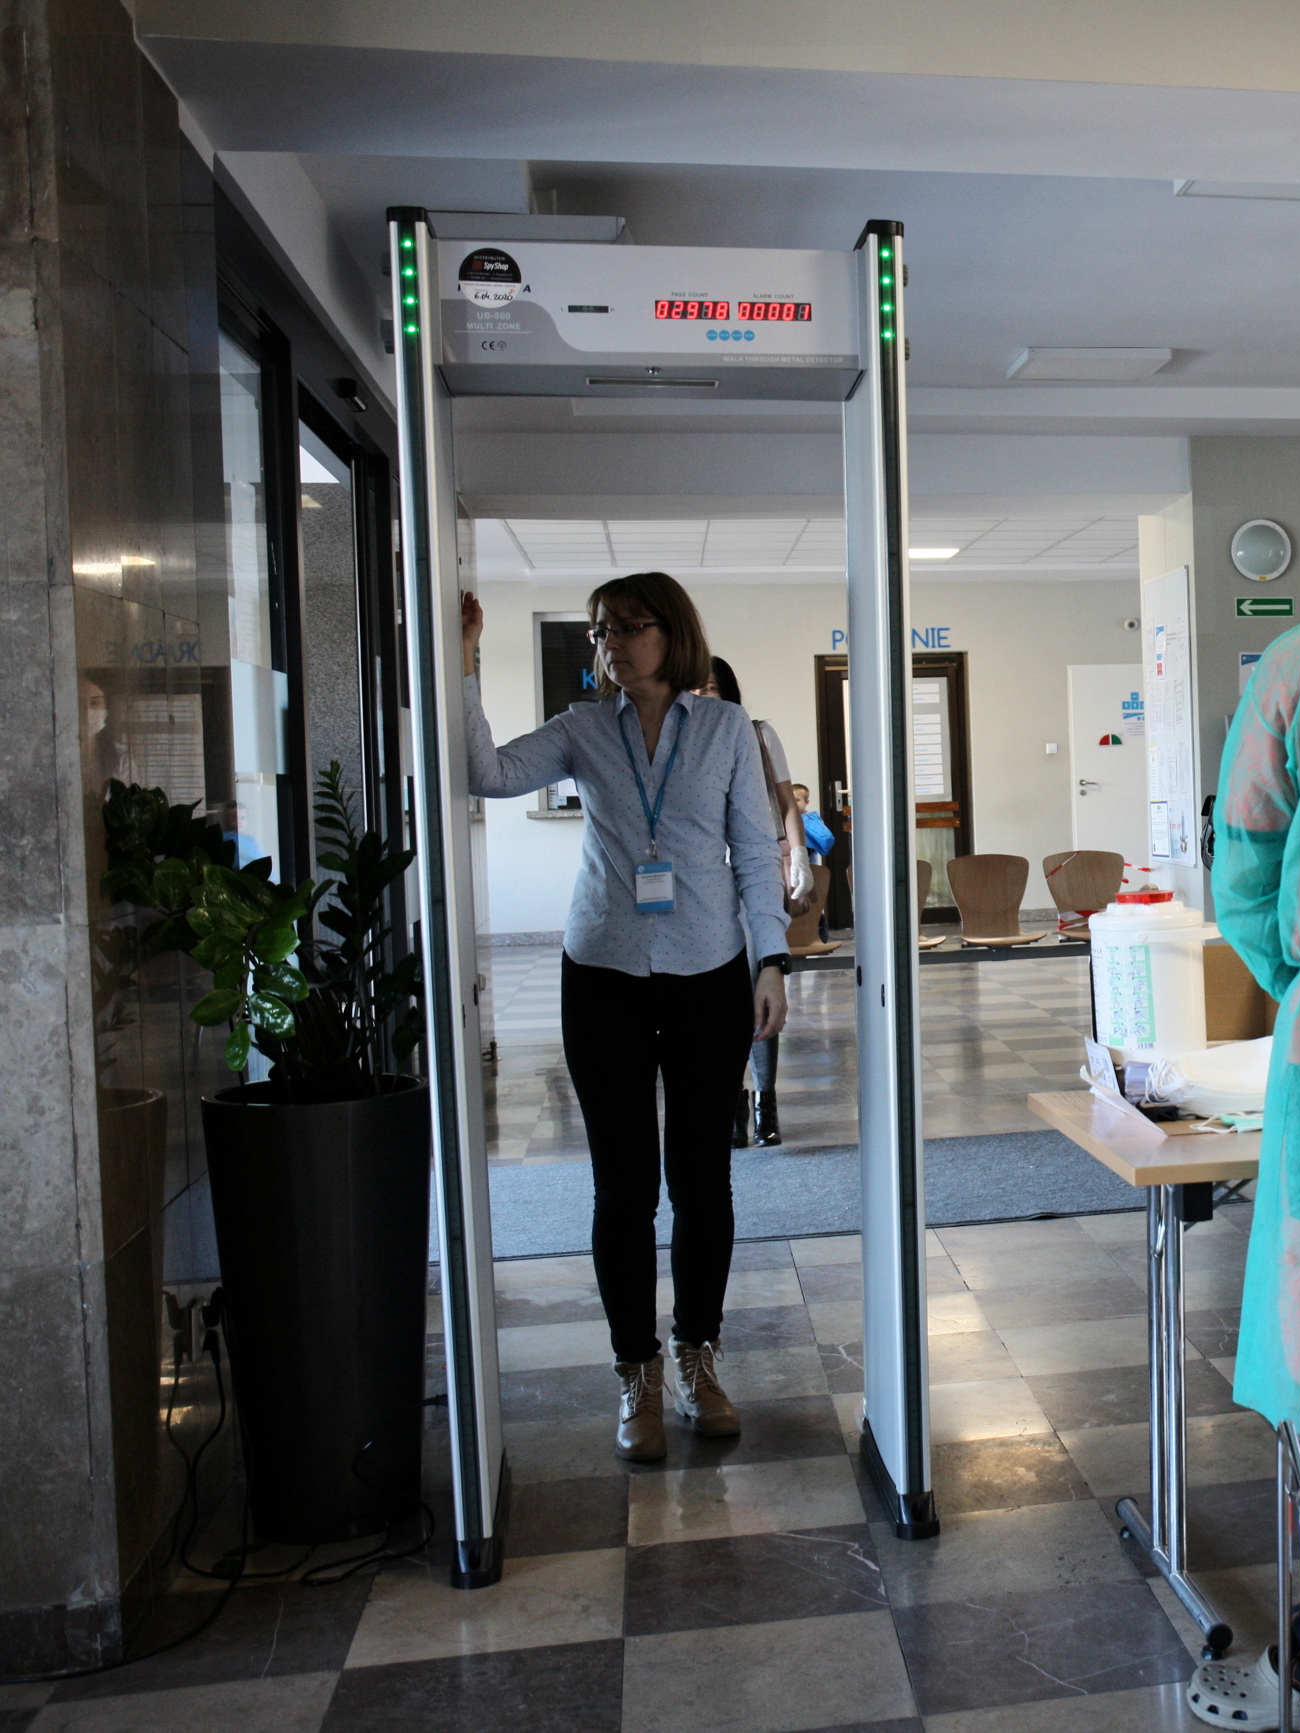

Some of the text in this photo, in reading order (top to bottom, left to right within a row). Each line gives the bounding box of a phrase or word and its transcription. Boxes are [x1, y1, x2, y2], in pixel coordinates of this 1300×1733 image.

[655, 300, 729, 320] 02978
[738, 302, 811, 322] 00001
[476, 311, 512, 320] UB-500
[466, 322, 521, 331] MULTI ZONE
[722, 355, 744, 363] WALK
[744, 356, 780, 364] THROUGH
